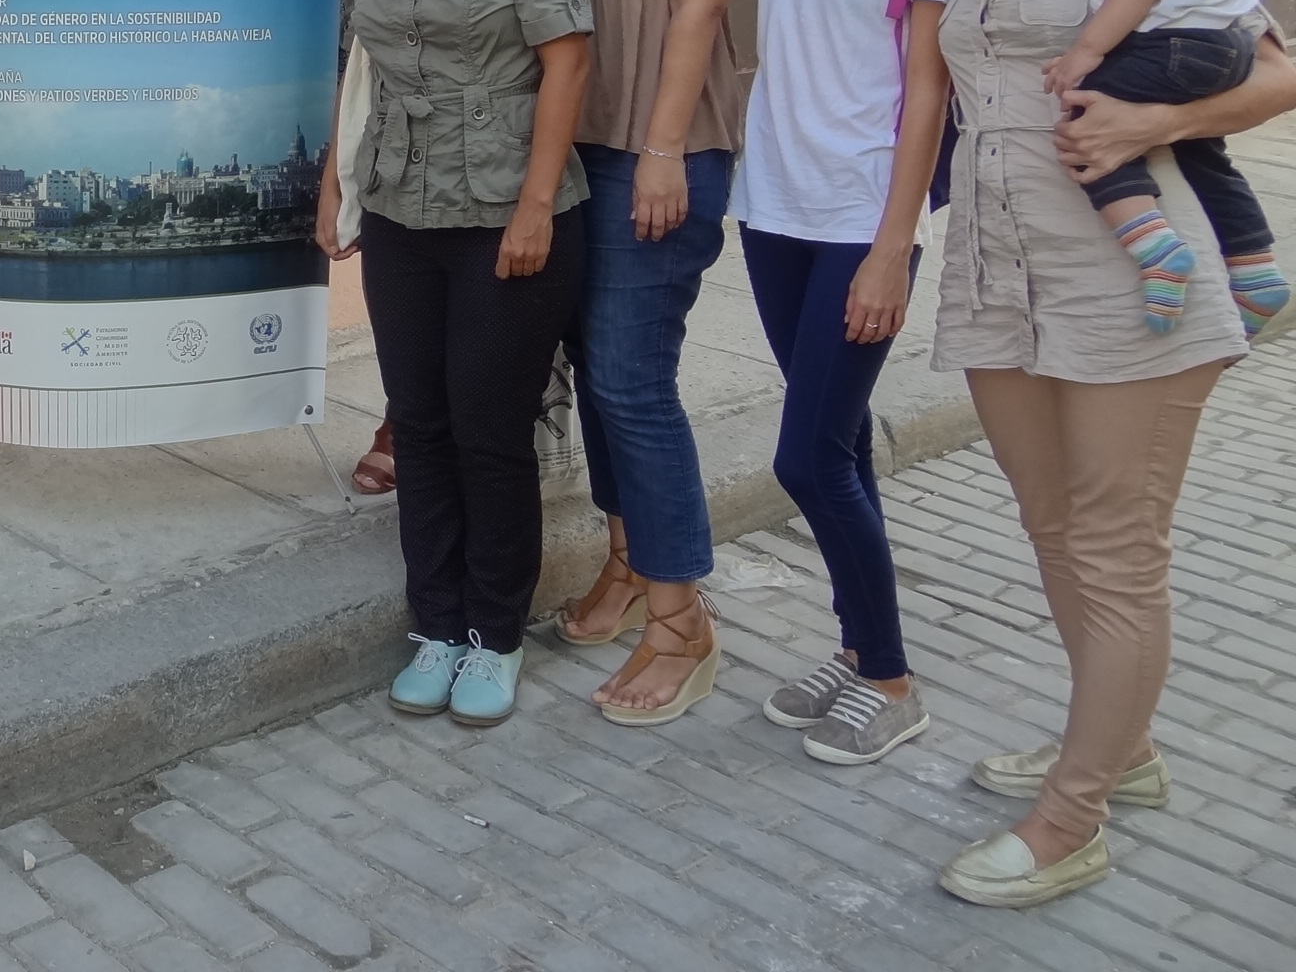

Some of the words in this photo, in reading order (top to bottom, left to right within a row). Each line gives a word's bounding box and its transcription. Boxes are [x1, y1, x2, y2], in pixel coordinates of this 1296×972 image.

[21, 13, 37, 25] DE
[40, 10, 88, 25] GÉNERO
[91, 12, 107, 25] EN
[110, 12, 124, 25] LA
[127, 12, 221, 25] SOSTENIBILIDAD
[35, 31, 57, 44] DEL
[59, 31, 107, 44] CENTRO
[109, 29, 170, 43] HISTÓRICO
[173, 30, 188, 43] LA
[191, 30, 239, 42] HABANA
[242, 29, 272, 41] VIEJA
[28, 89, 37, 102] Y
[39, 89, 80, 102] PATIOS
[83, 89, 129, 102] VERDES
[131, 89, 140, 101] Y
[142, 88, 198, 101] FLORIDOS
